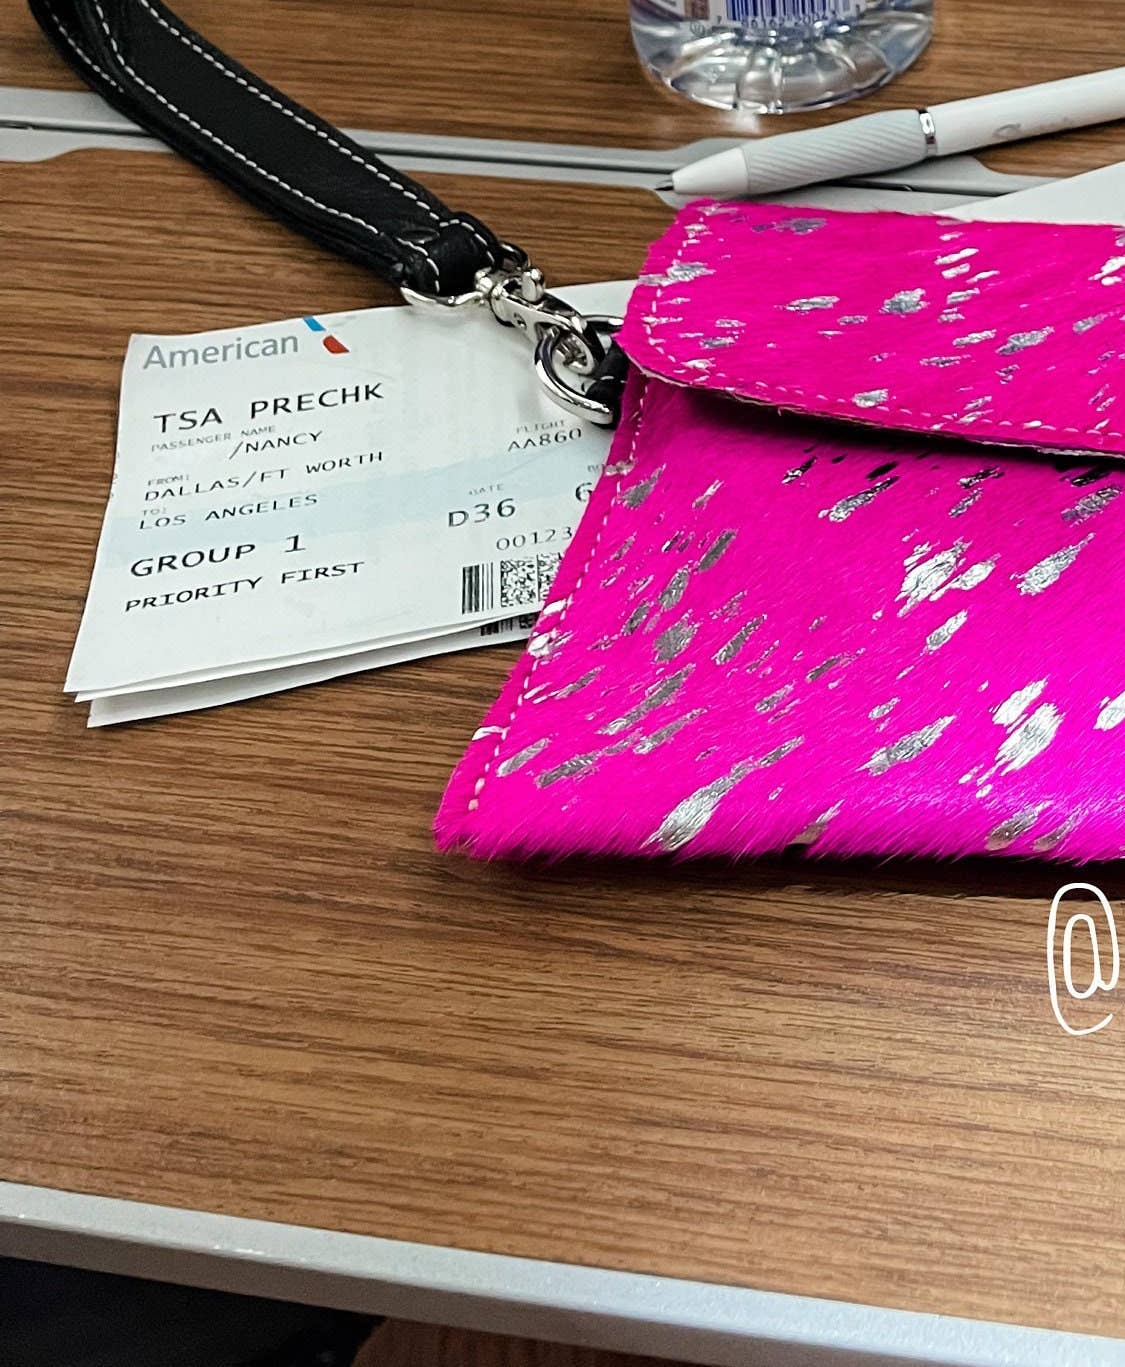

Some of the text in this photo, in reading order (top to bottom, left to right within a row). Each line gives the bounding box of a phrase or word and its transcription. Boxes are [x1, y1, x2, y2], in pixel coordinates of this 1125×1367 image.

[143, 335, 299, 370] American
[153, 383, 384, 434] TSA PRECHK
[152, 425, 277, 453] PASSENGER NAME
[507, 428, 582, 452] AA860
[516, 419, 565, 434] FLIGHT
[229, 431, 323, 460] /NANCY
[145, 451, 383, 502] DALLAS/FT WORTH
[139, 494, 318, 530] LOS ANGELES
[448, 498, 516, 527] D36
[496, 526, 573, 551] 00123
[130, 534, 306, 577] GROUP 1
[125, 561, 366, 612] PRIORITY FIRST
